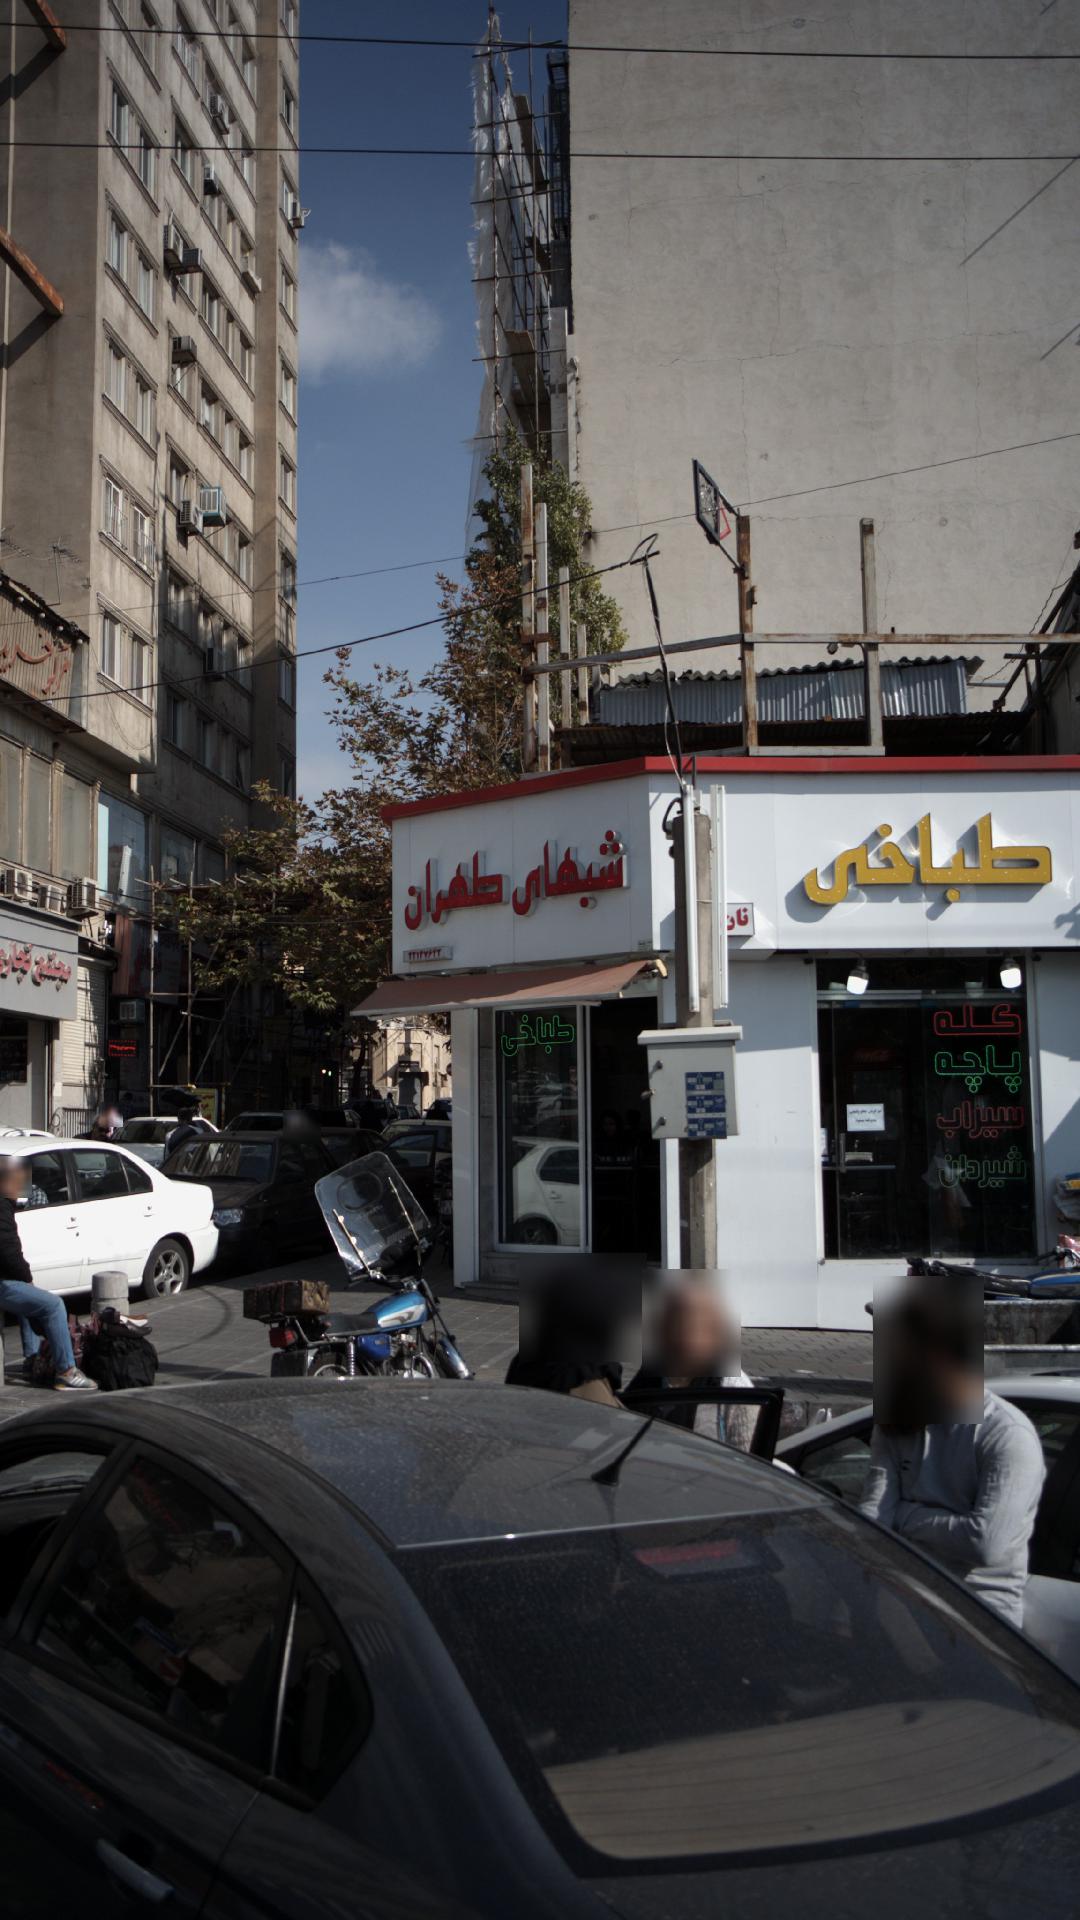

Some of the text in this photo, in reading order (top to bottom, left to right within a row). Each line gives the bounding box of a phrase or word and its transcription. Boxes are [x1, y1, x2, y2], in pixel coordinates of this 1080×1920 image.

[803, 812, 1053, 905] طباخی
[404, 850, 506, 931] طهران
[501, 1013, 576, 1057] طباخی
[933, 1003, 1022, 1036] کله
[934, 1044, 1022, 1094] پاچه
[935, 1100, 1026, 1139] سیراب
[938, 1146, 1027, 1189] شیردان
